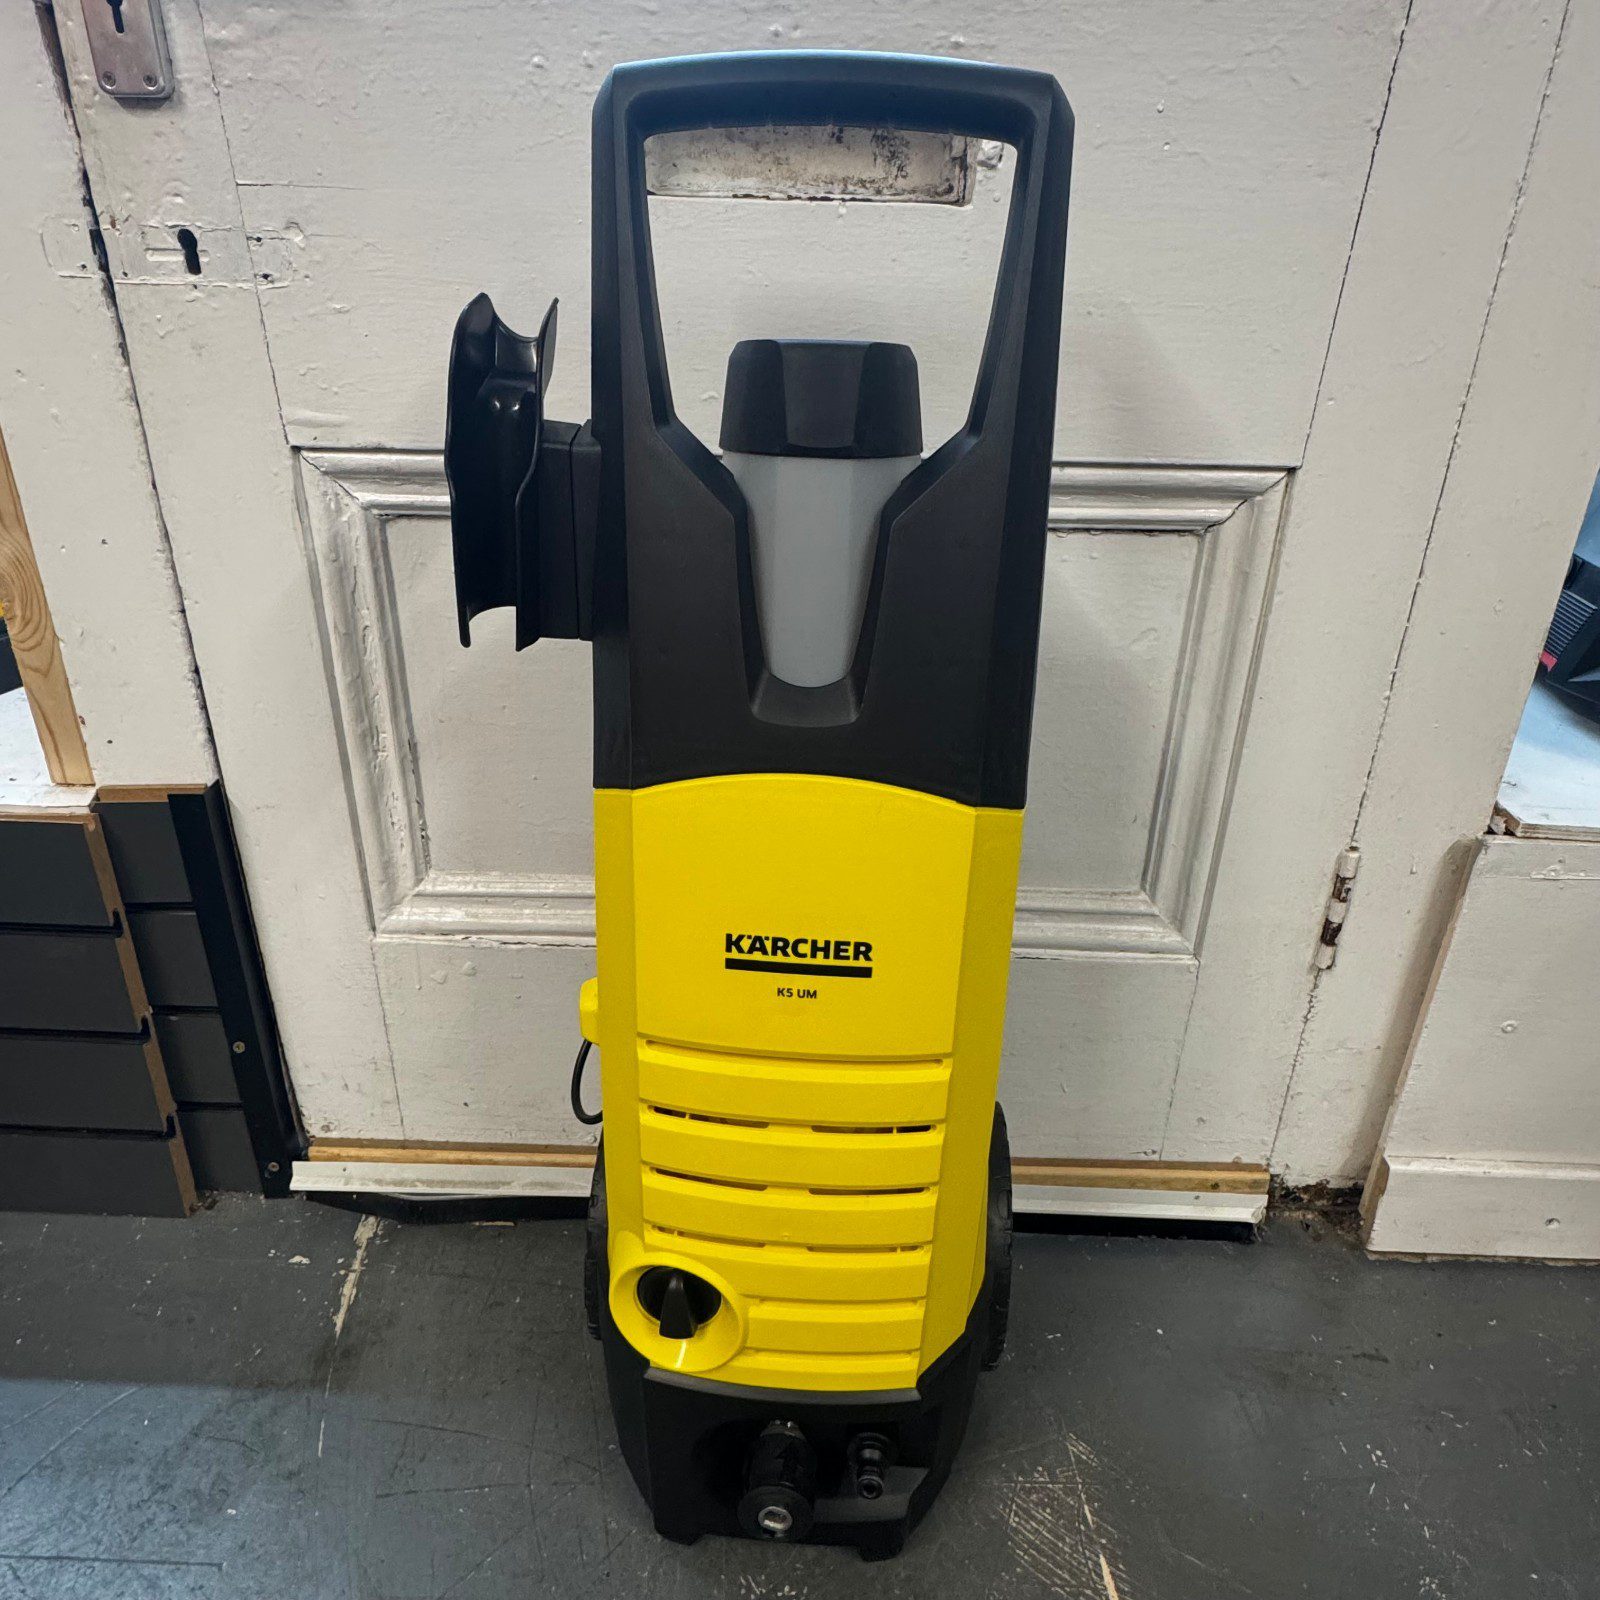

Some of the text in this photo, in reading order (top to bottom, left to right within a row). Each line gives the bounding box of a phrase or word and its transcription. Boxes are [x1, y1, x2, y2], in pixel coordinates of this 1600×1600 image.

[725, 933, 873, 962] KÄRCHER
[776, 987, 818, 999] K5 UM
